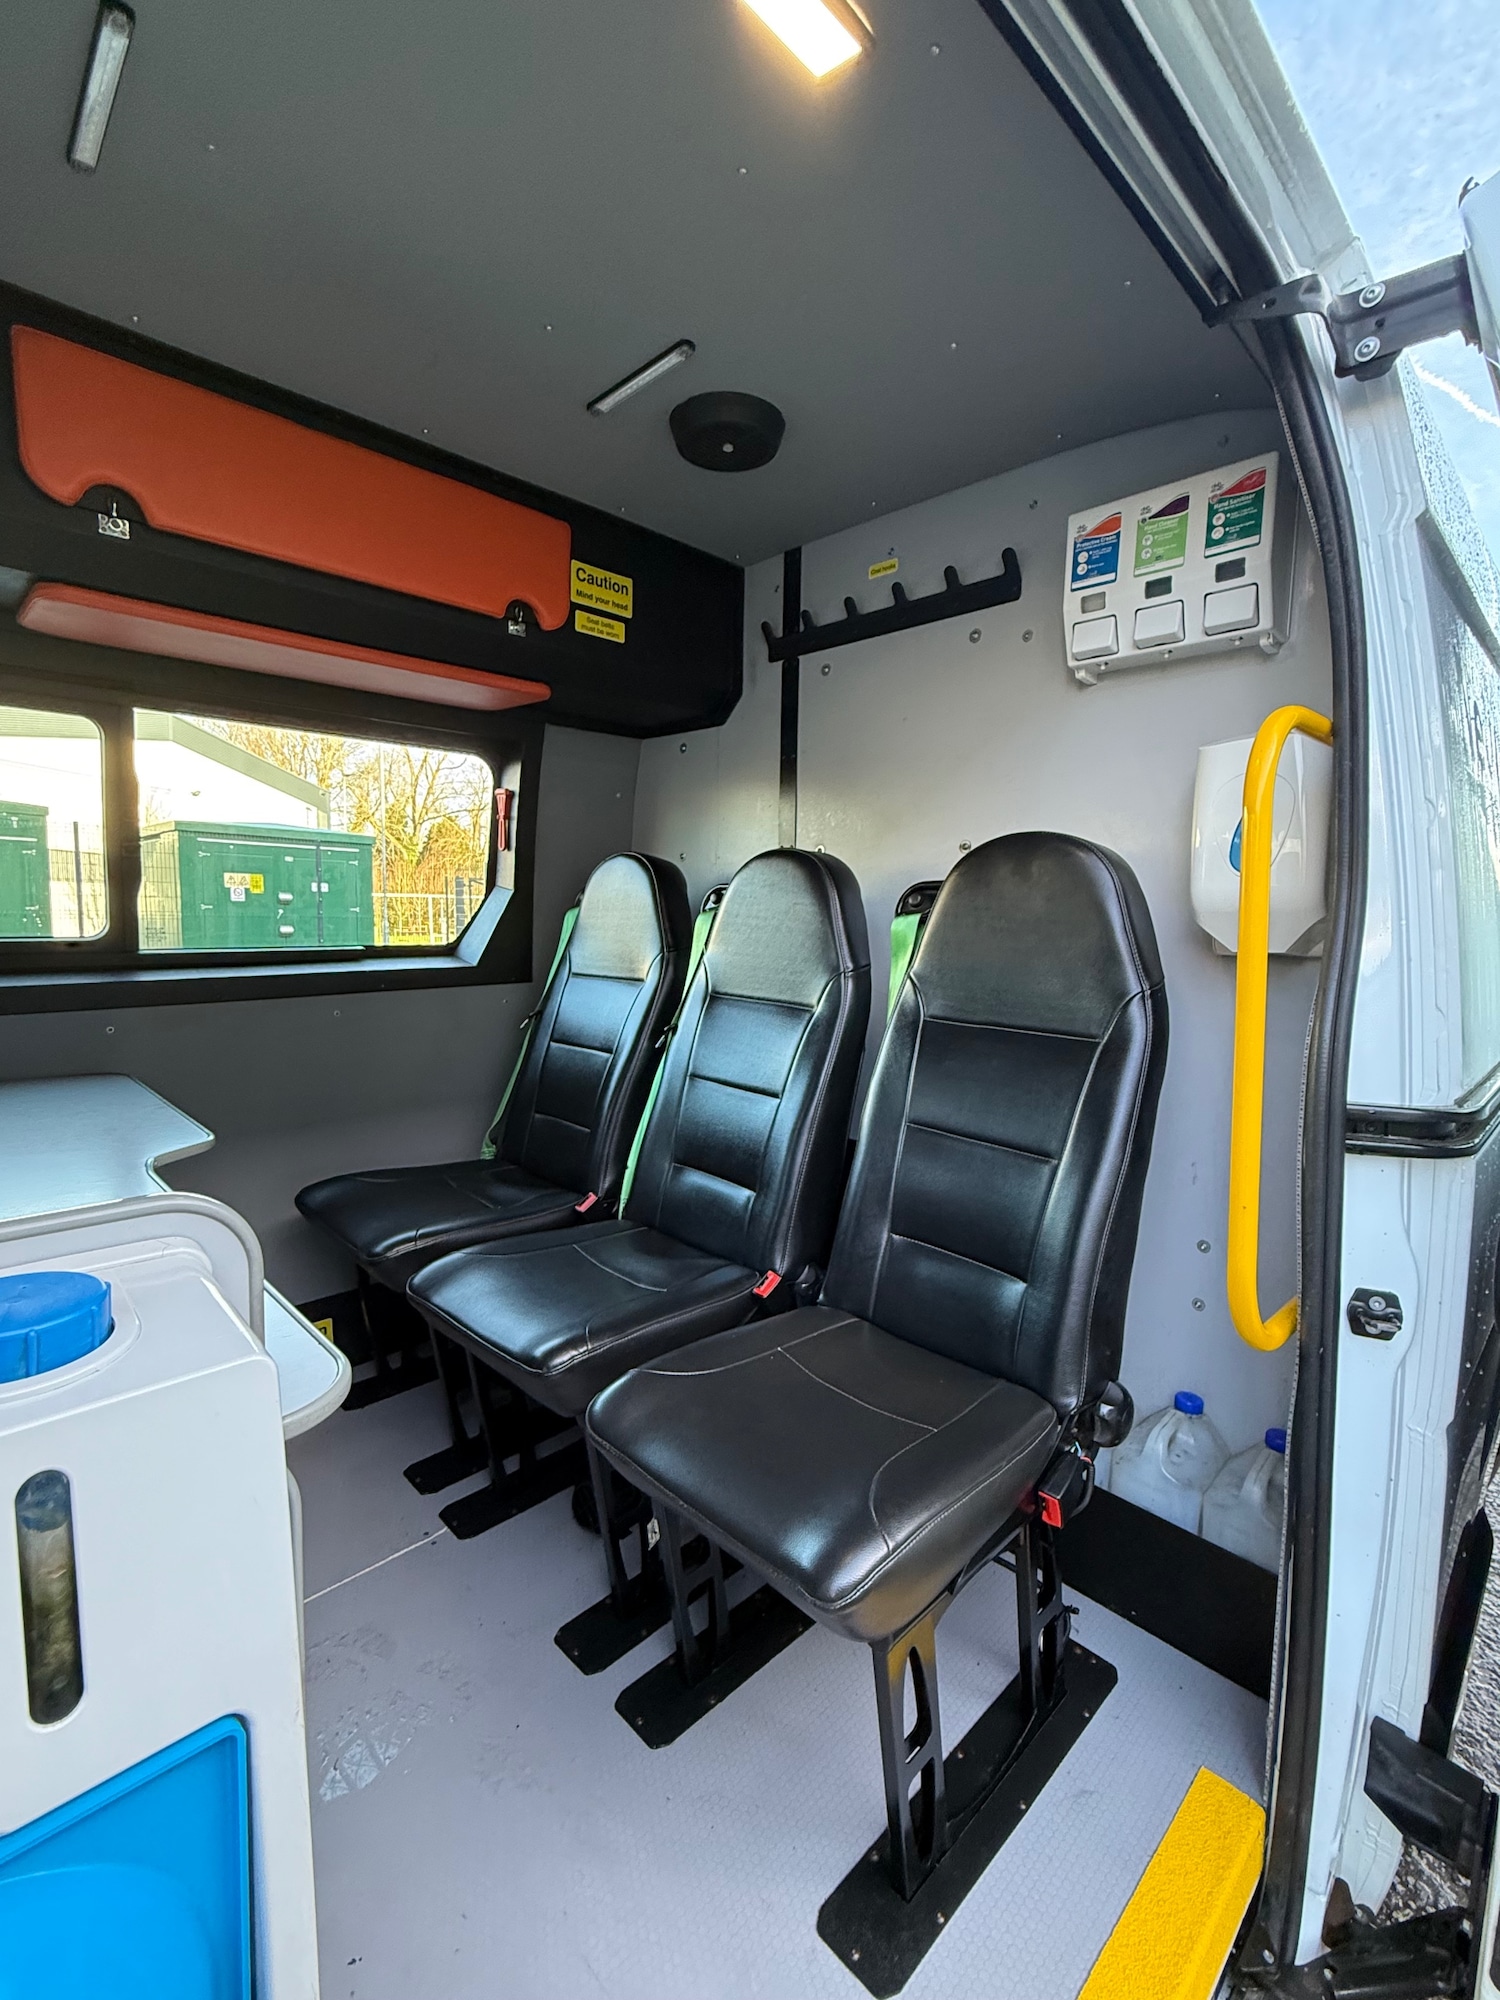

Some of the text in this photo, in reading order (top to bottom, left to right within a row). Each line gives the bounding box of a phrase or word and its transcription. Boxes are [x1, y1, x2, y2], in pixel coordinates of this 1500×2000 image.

[576, 567, 629, 595] Caution
[576, 589, 629, 611] Mind your head
[581, 624, 595, 632] must
[597, 627, 604, 635] be
